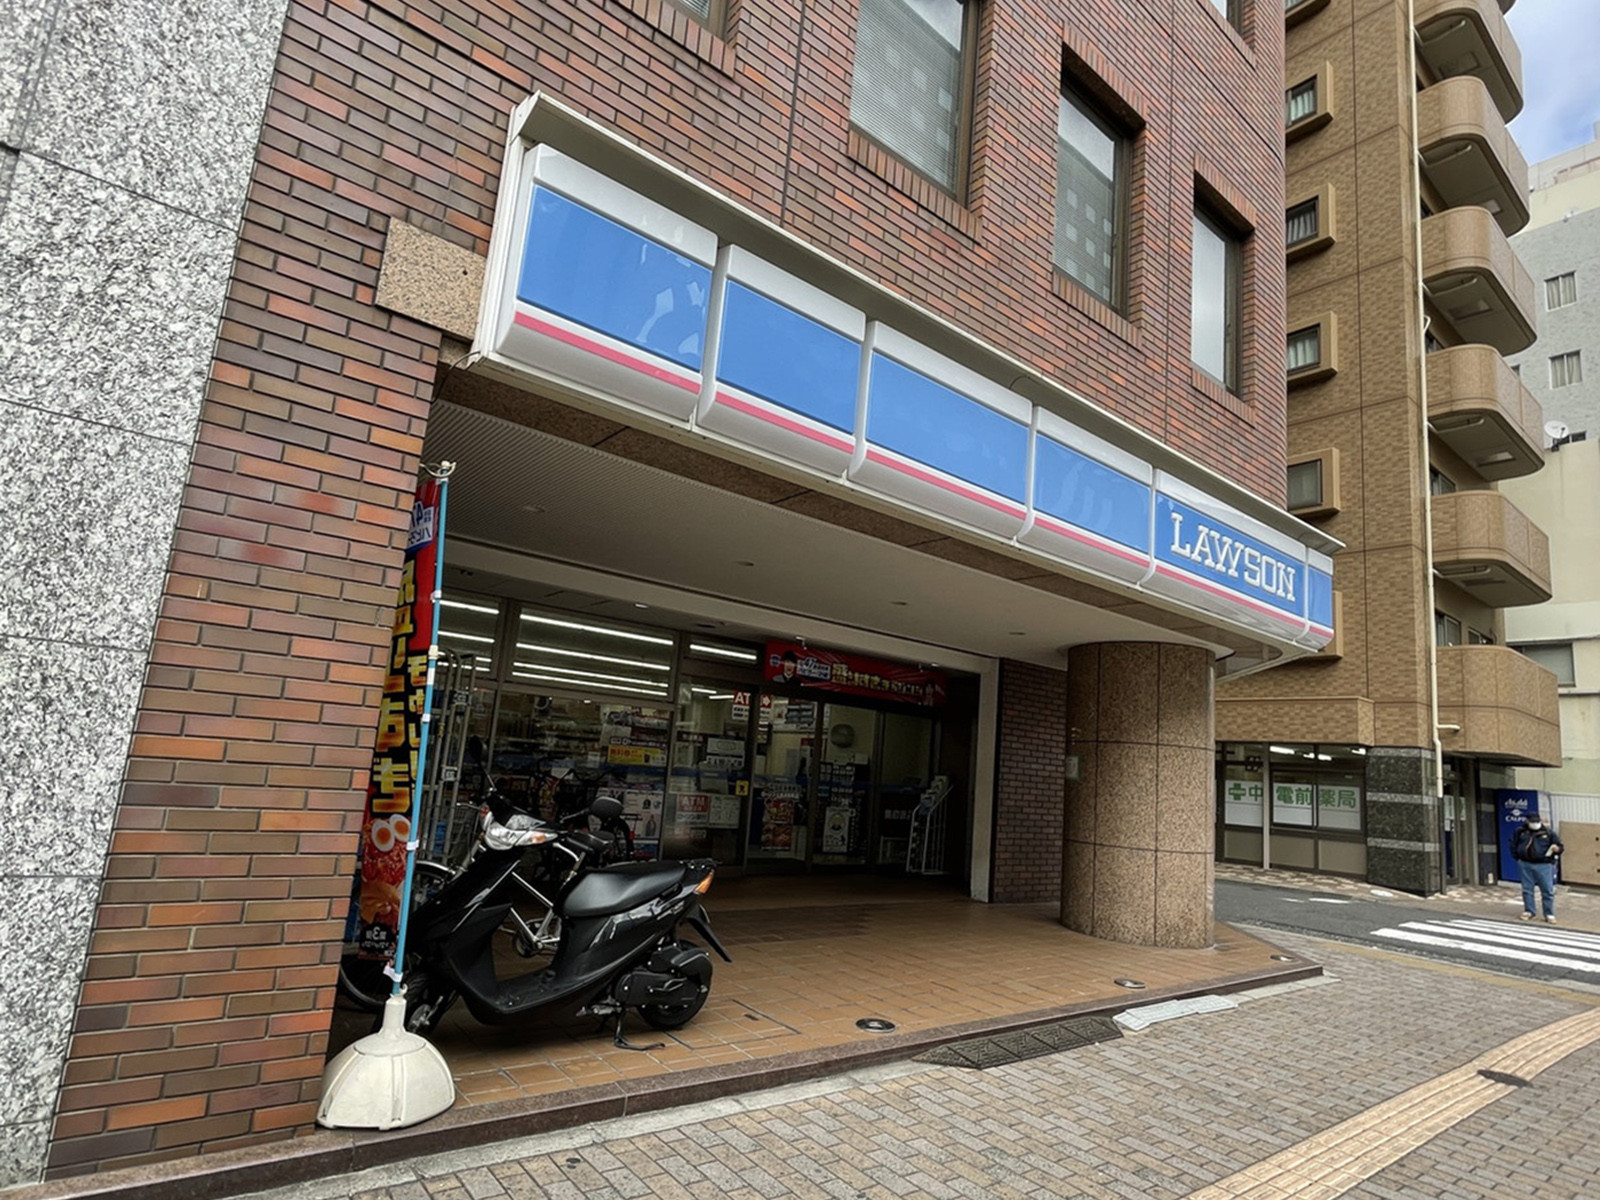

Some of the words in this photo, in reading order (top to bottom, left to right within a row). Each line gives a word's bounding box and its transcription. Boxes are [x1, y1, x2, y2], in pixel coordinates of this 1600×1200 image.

[1171, 513, 1296, 602] LAWSON
[734, 691, 752, 705] AT
[681, 796, 705, 807] ATM
